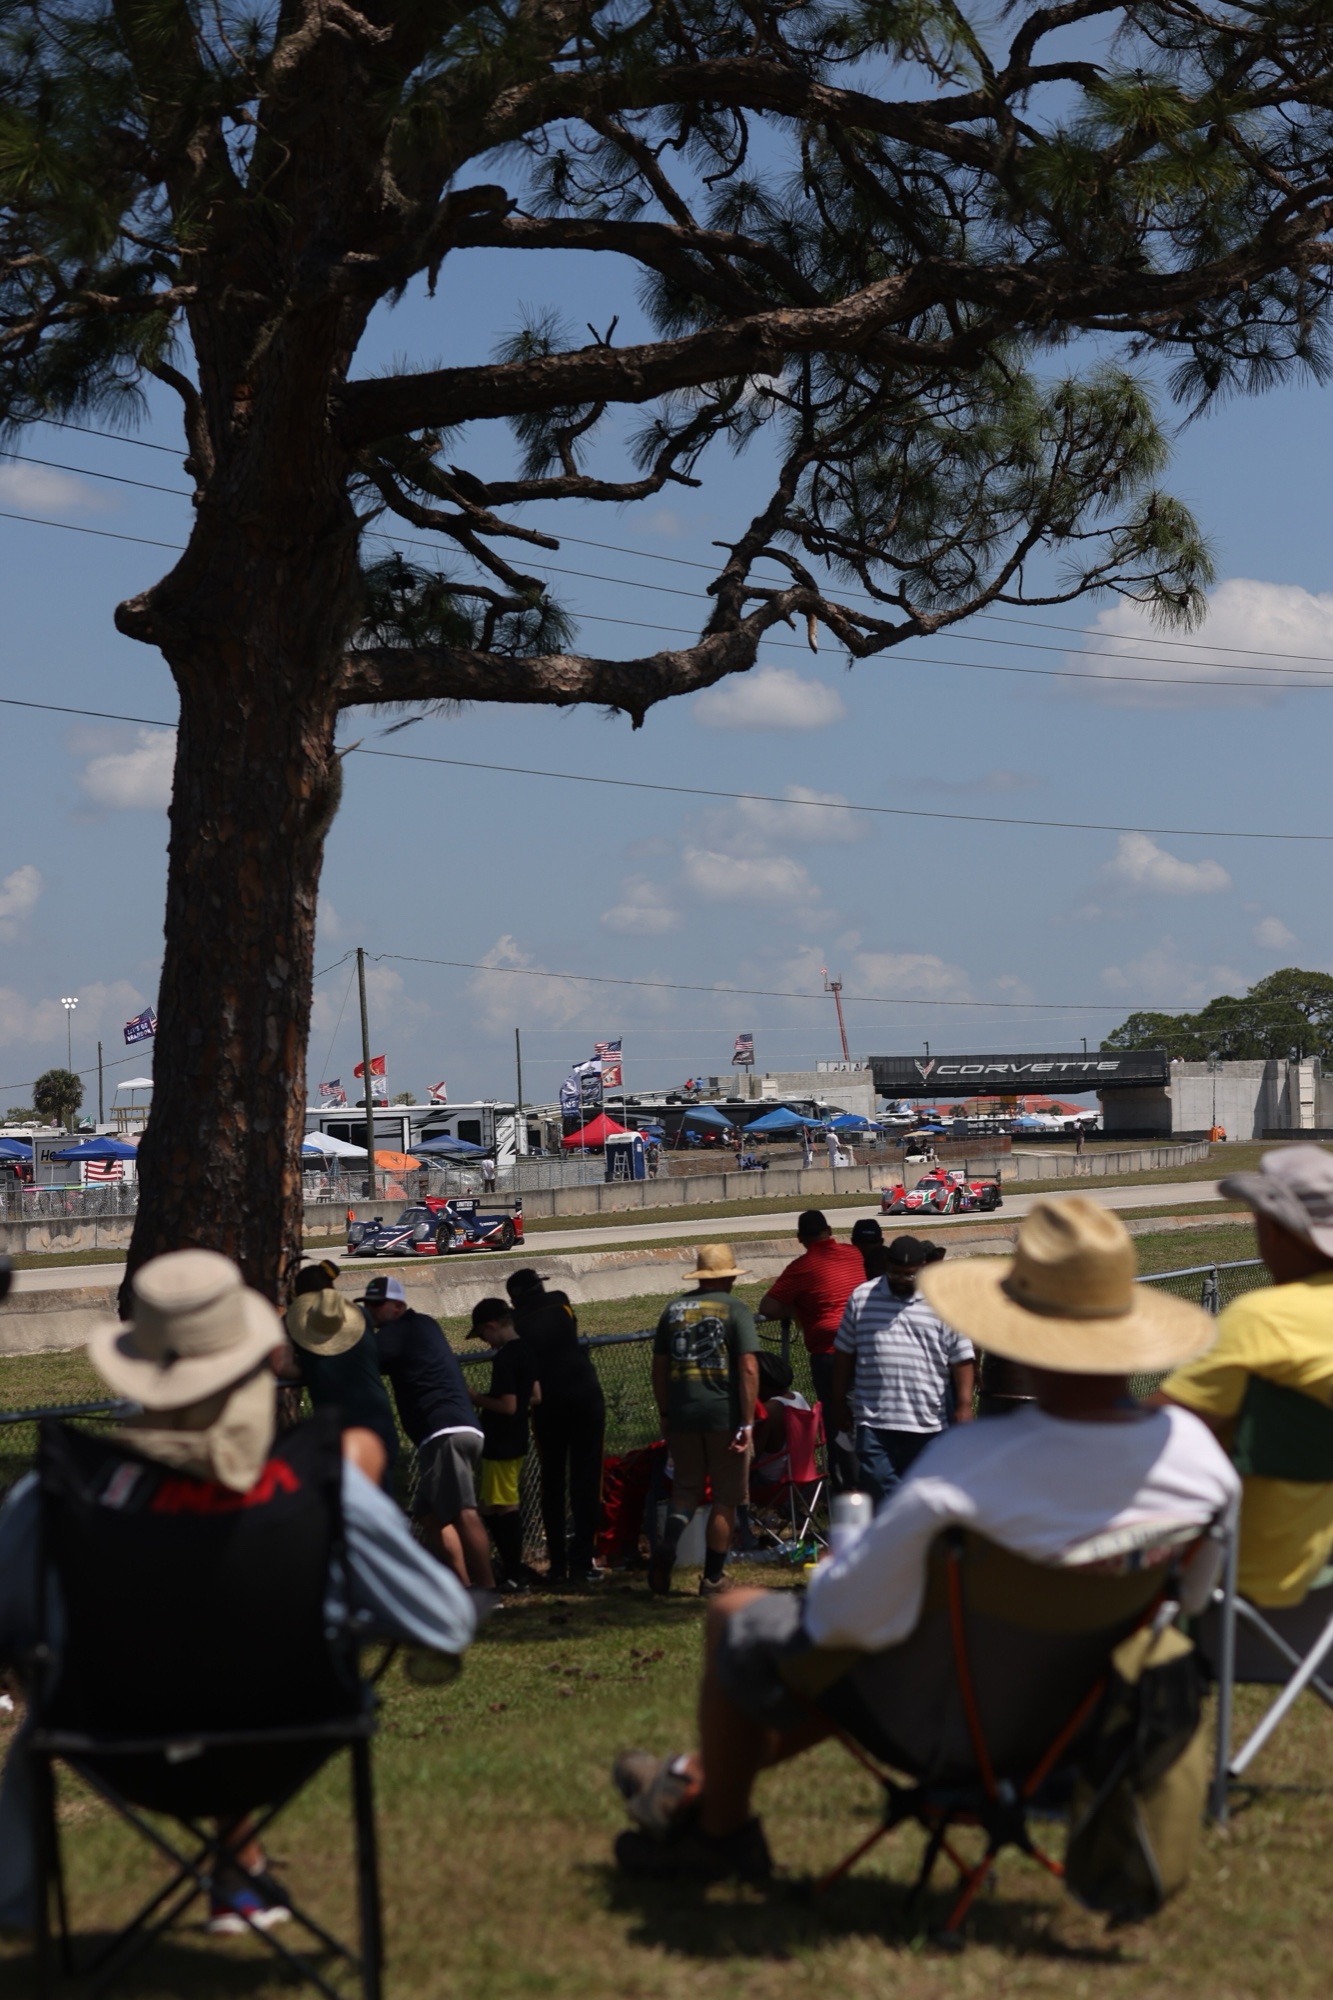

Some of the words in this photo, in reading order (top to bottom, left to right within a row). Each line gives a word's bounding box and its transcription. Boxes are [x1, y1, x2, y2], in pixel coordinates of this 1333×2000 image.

[140, 1022, 149, 1030] GO
[127, 1028, 152, 1041] BRANDON
[936, 1060, 1121, 1075] CORVETTE
[455, 1234, 464, 1245] 23
[669, 1301, 701, 1311] ROLEX
